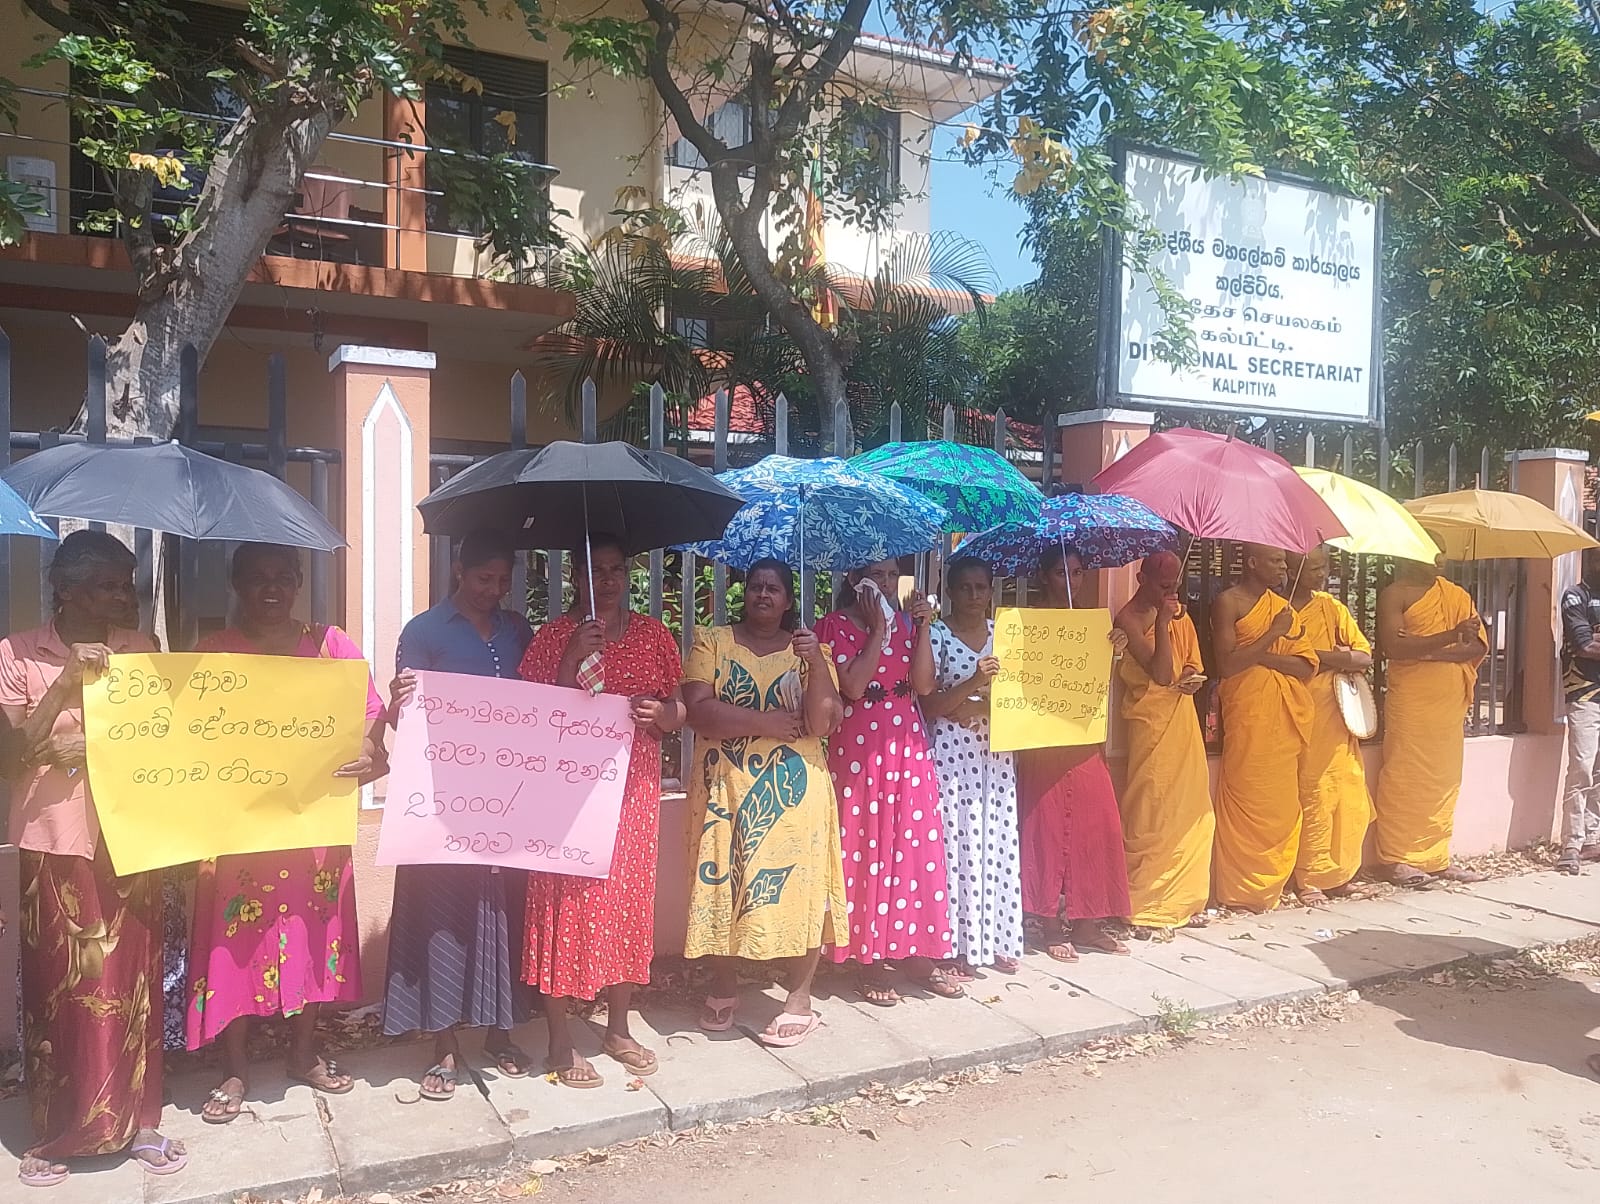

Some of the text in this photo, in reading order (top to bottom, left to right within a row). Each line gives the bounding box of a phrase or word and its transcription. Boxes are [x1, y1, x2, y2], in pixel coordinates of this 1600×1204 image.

[1212, 238, 1286, 268] මහලේකම්
[1292, 254, 1360, 282] කාර්යාලය
[1243, 306, 1342, 333] செயலகம்
[1129, 342, 1363, 383] DINAL SECRETARIAT
[1212, 377, 1277, 398] KALPITIYA
[1003, 648, 1044, 661] 25000
[189, 670, 248, 701] ආවා
[424, 741, 486, 765] වෙලා
[496, 748, 547, 773] මාස
[132, 758, 288, 786] ගොඩ ගියා
[444, 832, 513, 854] තවම
